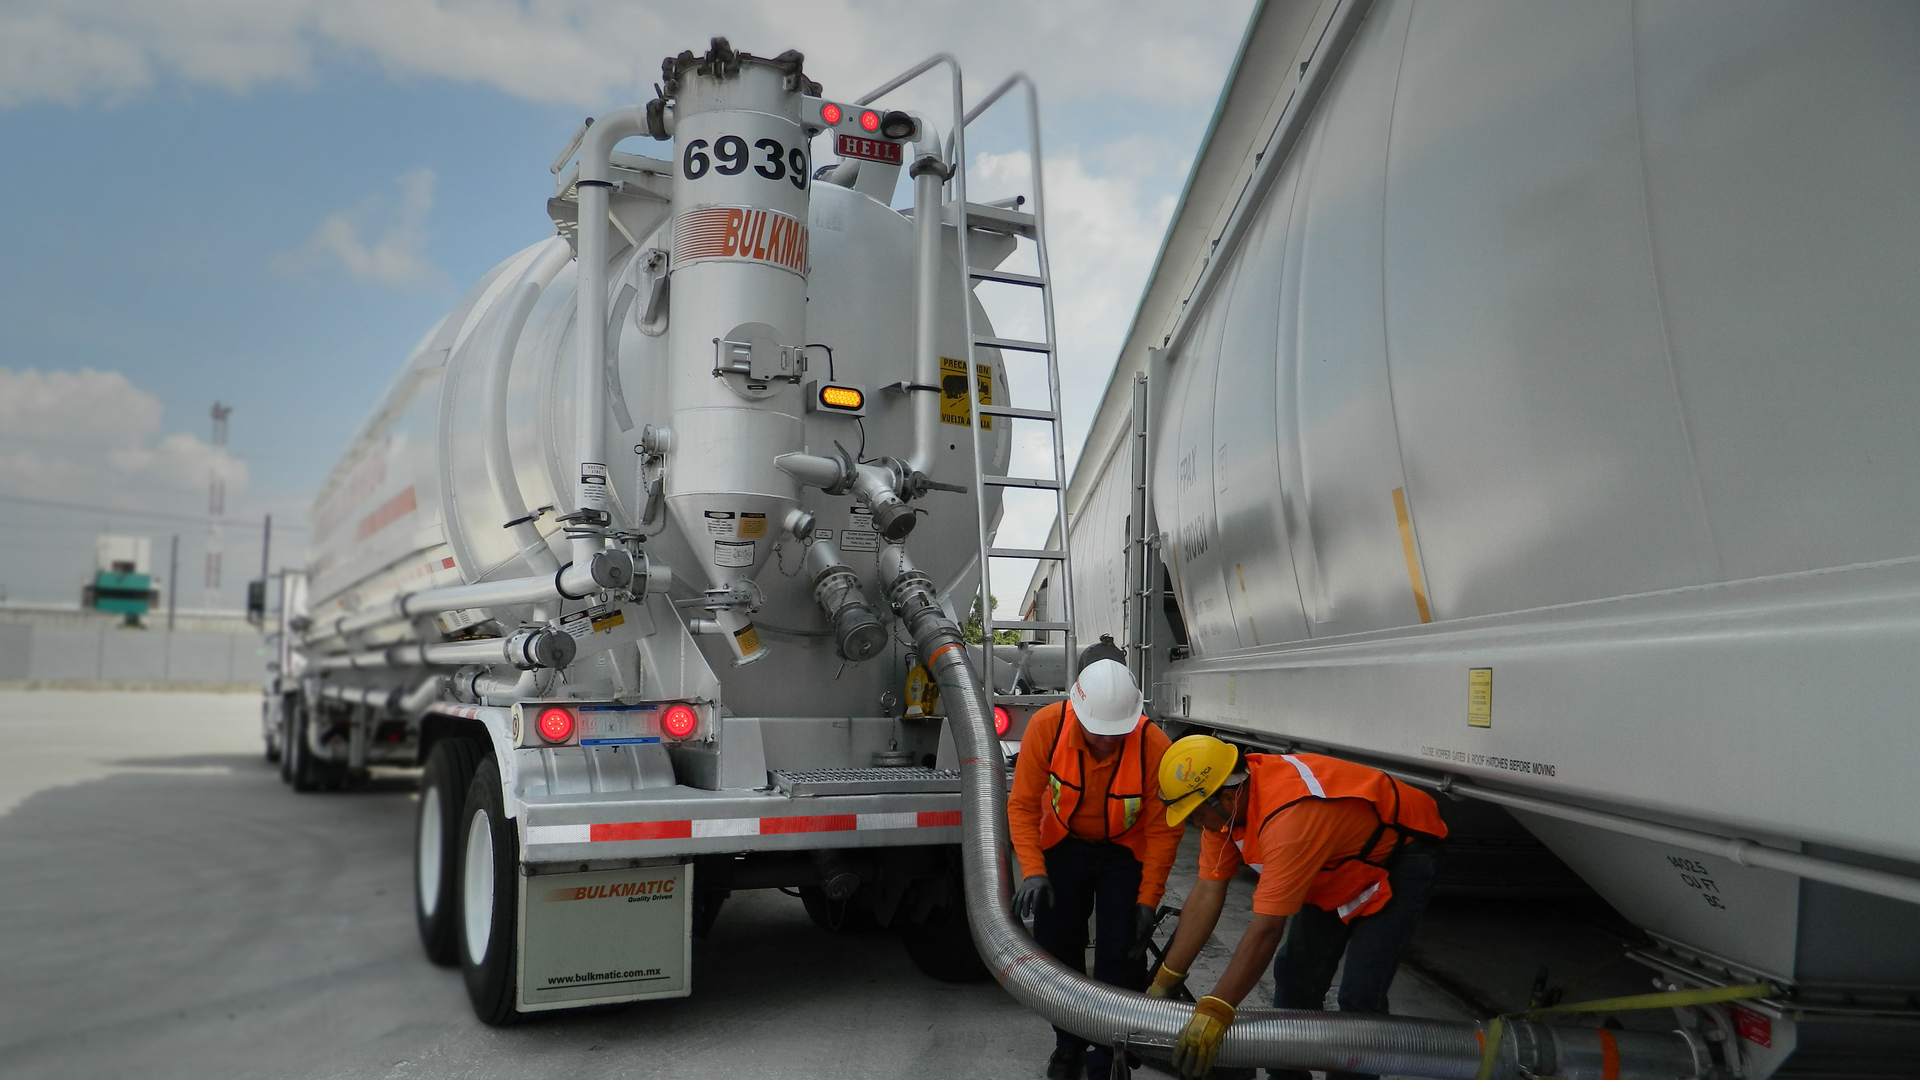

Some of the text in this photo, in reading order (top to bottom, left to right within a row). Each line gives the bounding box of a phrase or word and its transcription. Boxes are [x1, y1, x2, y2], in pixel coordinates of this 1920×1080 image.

[845, 137, 894, 159] HEIL
[683, 135, 807, 191] 6939
[943, 358, 989, 375] PRECAION
[941, 413, 991, 429] VUELTA ALIA
[1421, 745, 1434, 757] CLOSE
[1435, 748, 1451, 760] HOPPER
[1451, 751, 1466, 763] GATES
[1471, 754, 1485, 766] ROOF
[1486, 756, 1508, 770] HATCHES
[1509, 759, 1531, 774] BEFORE
[1532, 762, 1556, 777] MOVING
[575, 879, 675, 900] BULKMATIC
[1680, 872, 1720, 893] CU FT
[628, 893, 673, 903] Quality Driven
[547, 967, 661, 985] www.bulkmatic.com.mx
